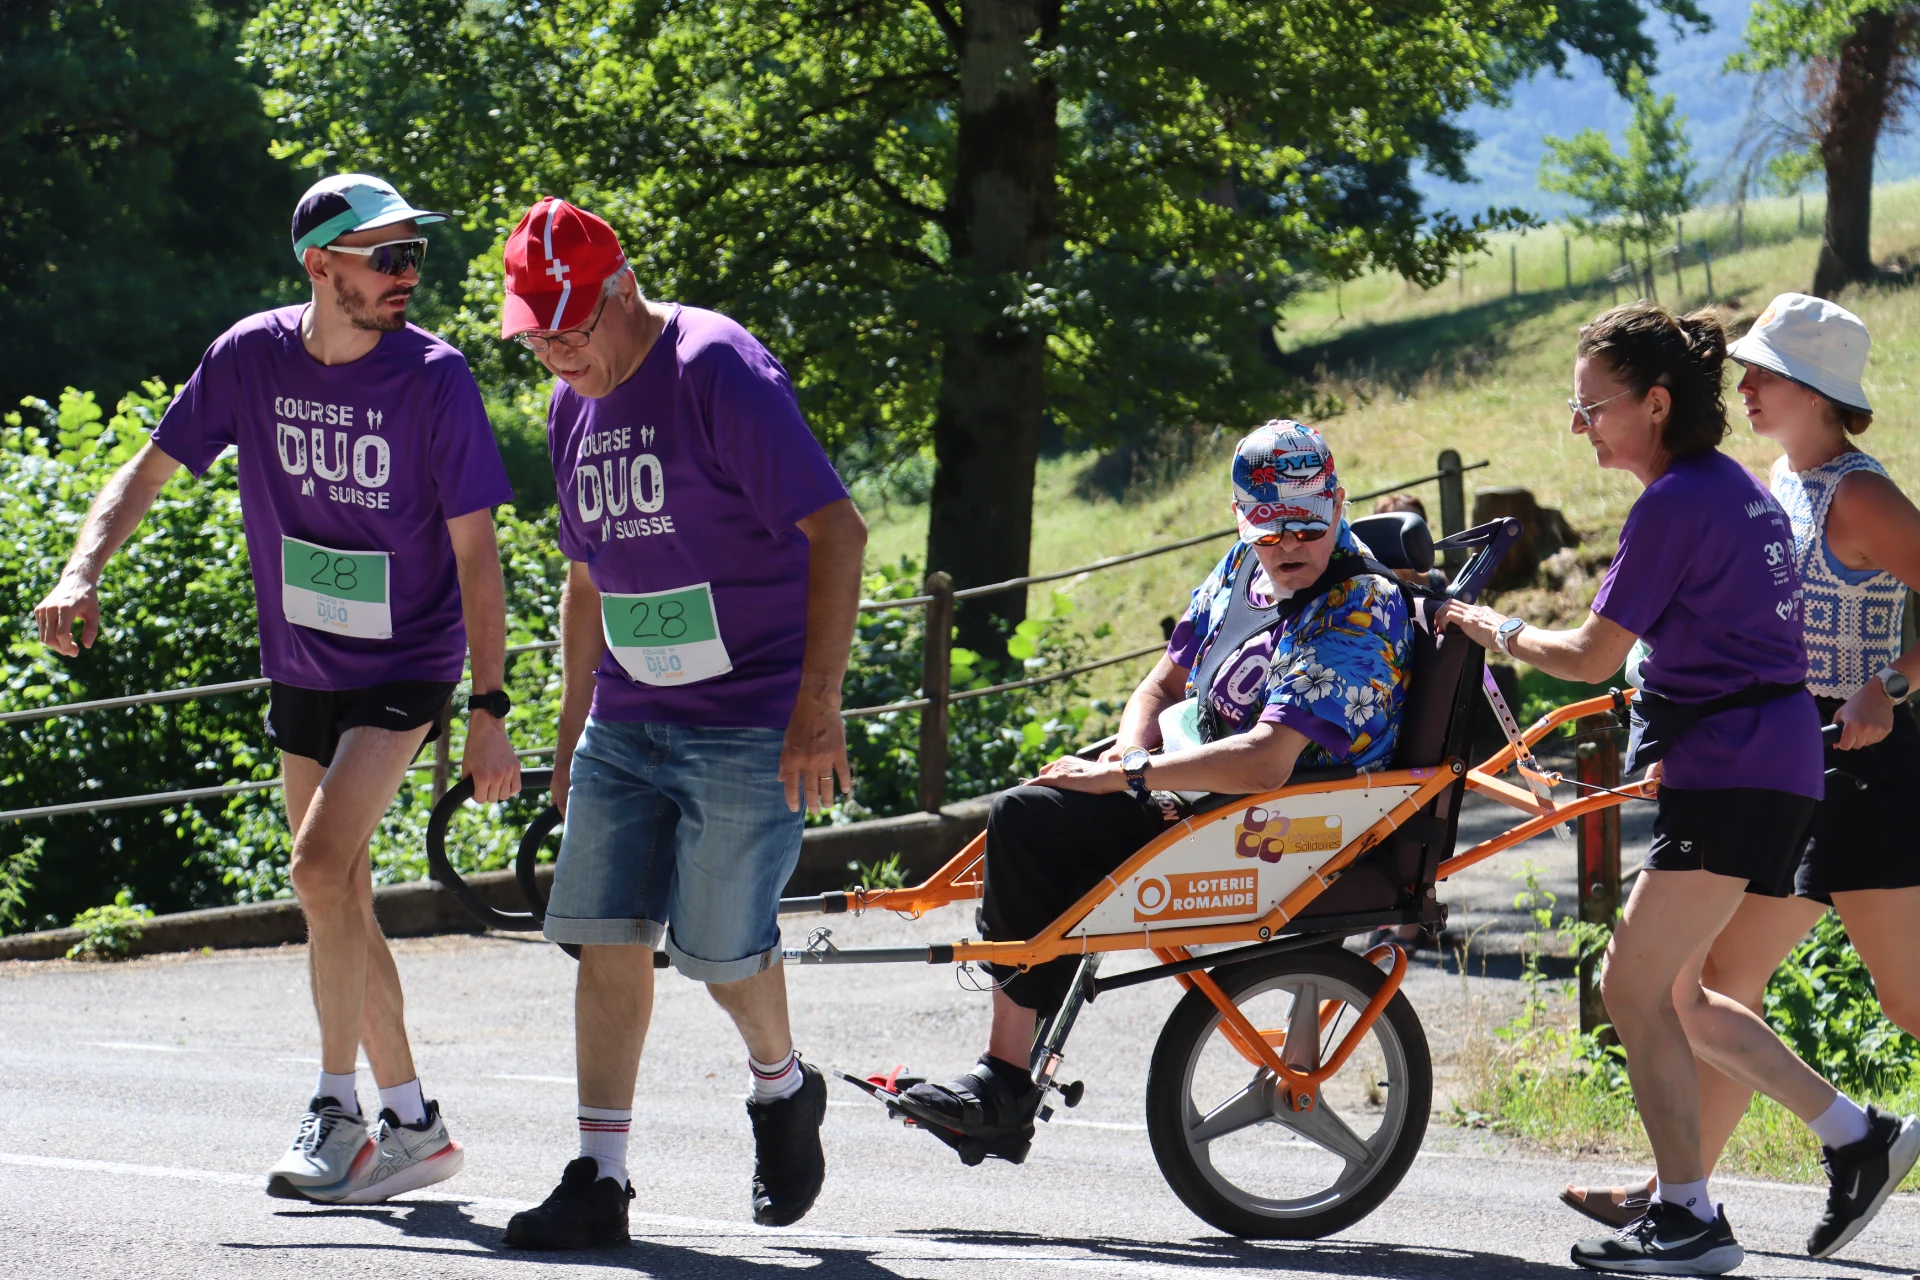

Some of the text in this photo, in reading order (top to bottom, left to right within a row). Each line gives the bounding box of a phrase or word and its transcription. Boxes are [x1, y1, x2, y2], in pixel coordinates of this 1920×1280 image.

[274, 396, 354, 427] COURSE
[276, 422, 391, 489] DUO
[328, 485, 390, 510] SUISSE
[577, 453, 664, 524] DUO
[614, 515, 676, 541] SUISSE
[310, 551, 358, 591] 28
[317, 602, 348, 623] DUO
[630, 600, 687, 639] 28
[645, 655, 682, 672] DUO
[1295, 840, 1341, 852] Solidaires
[1188, 876, 1254, 893] LOTERIE
[1173, 893, 1254, 911] ROMANDE
